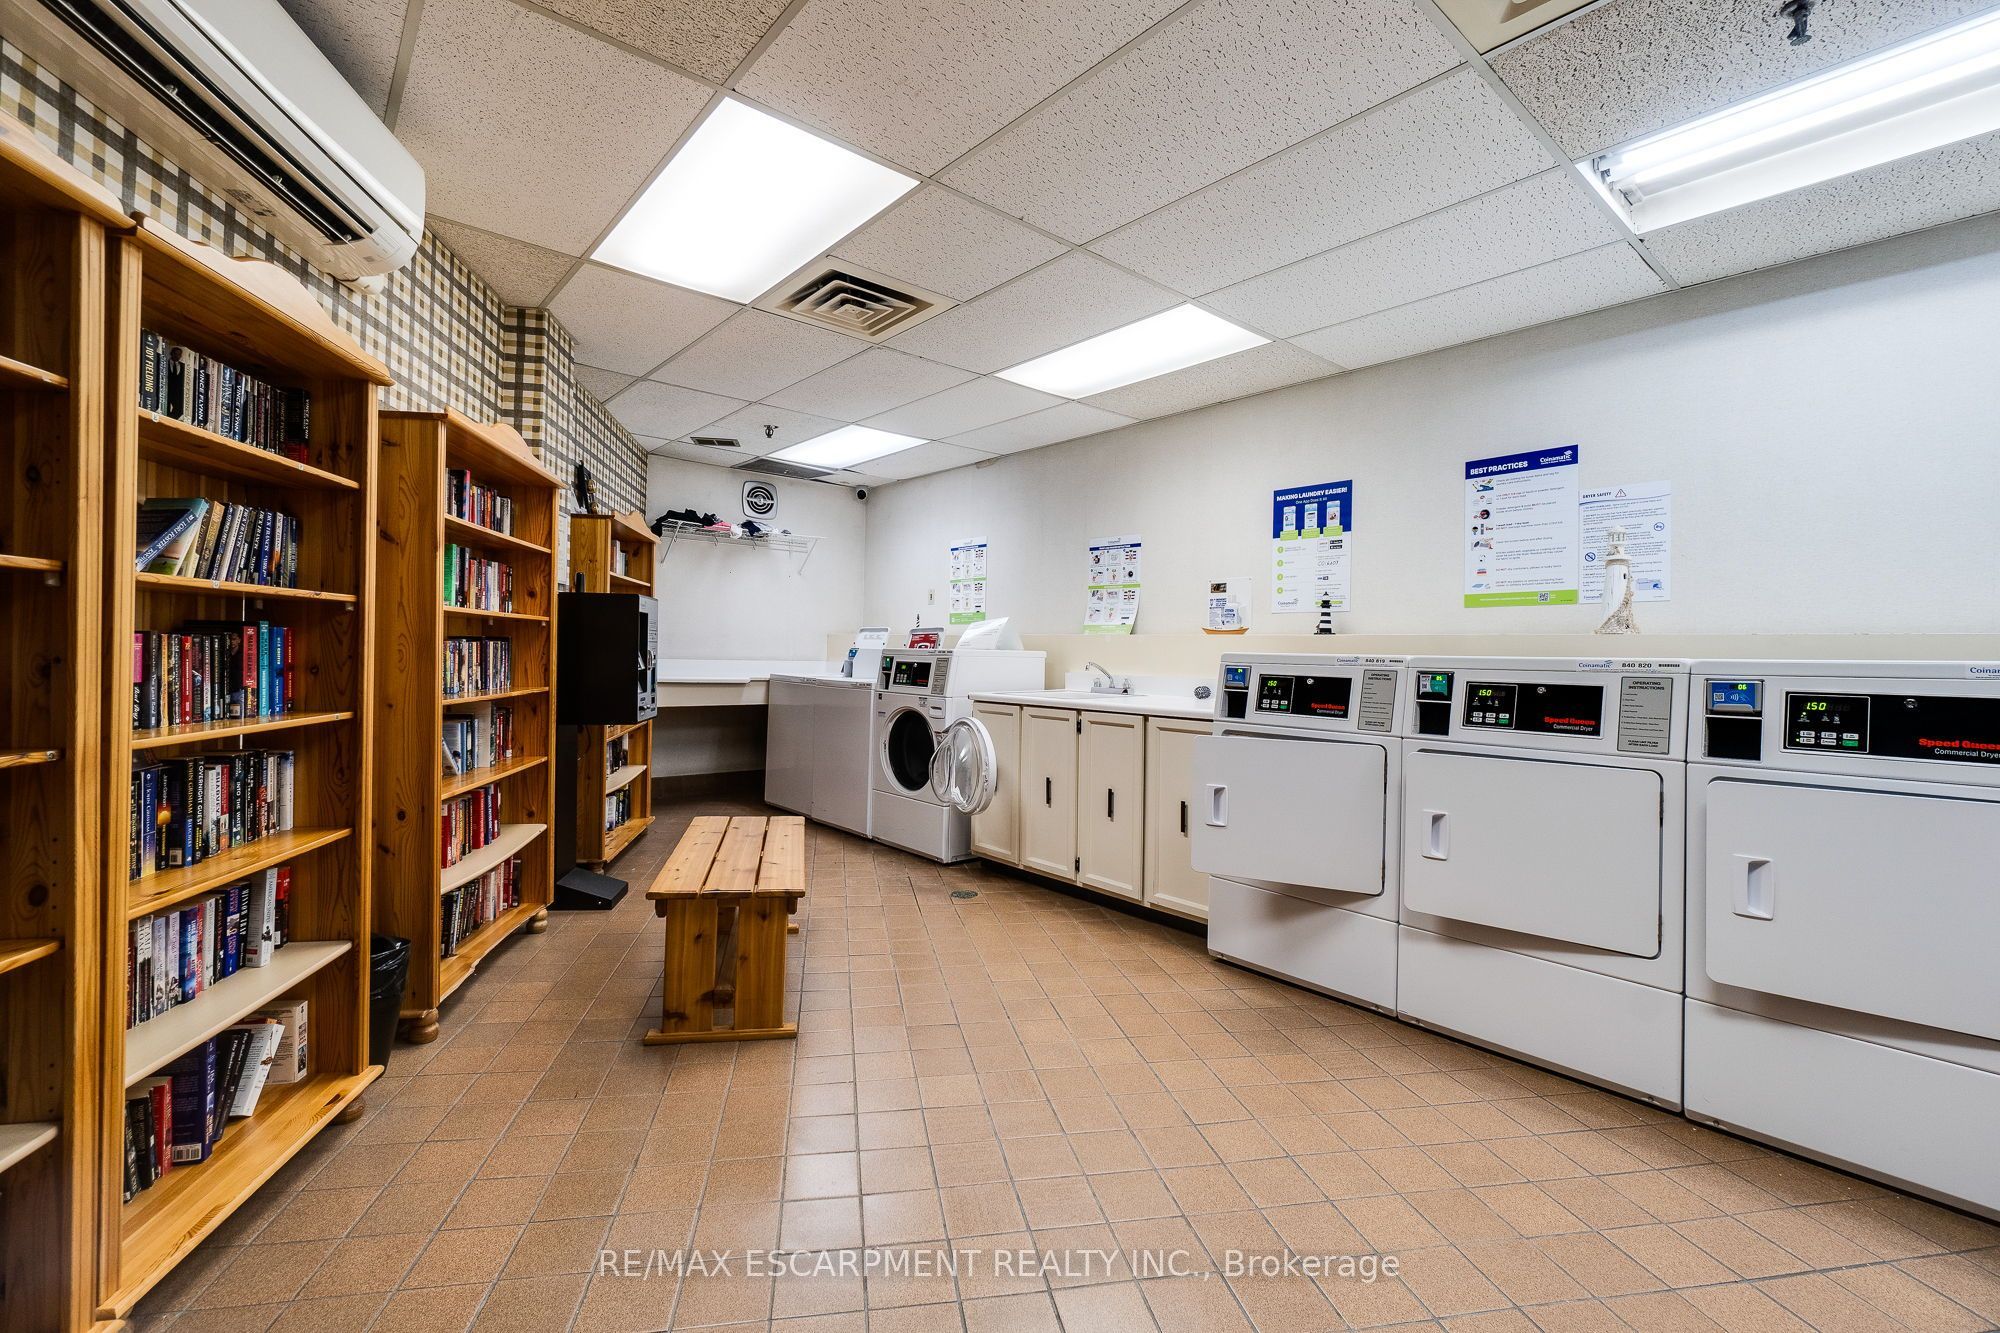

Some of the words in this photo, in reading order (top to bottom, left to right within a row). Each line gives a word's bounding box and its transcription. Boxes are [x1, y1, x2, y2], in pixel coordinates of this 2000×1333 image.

[145, 345, 154, 360] JOY
[145, 360, 154, 394] FIELDING
[1540, 451, 1572, 463] Coinamatic
[1470, 466, 1488, 475] BEST
[1488, 461, 1528, 472] PRACTICES
[1299, 490, 1325, 499] LAUNDRY
[1325, 487, 1348, 495] EASIER!
[155, 530, 176, 550] FOSTER
[236, 523, 246, 548] FRANCIS
[254, 525, 262, 550] FRANCIS
[1578, 660, 1613, 668] Coinamatic
[1544, 716, 1569, 725] Speed
[1918, 739, 1960, 748] Speed
[1934, 747, 1979, 757] Commercial
